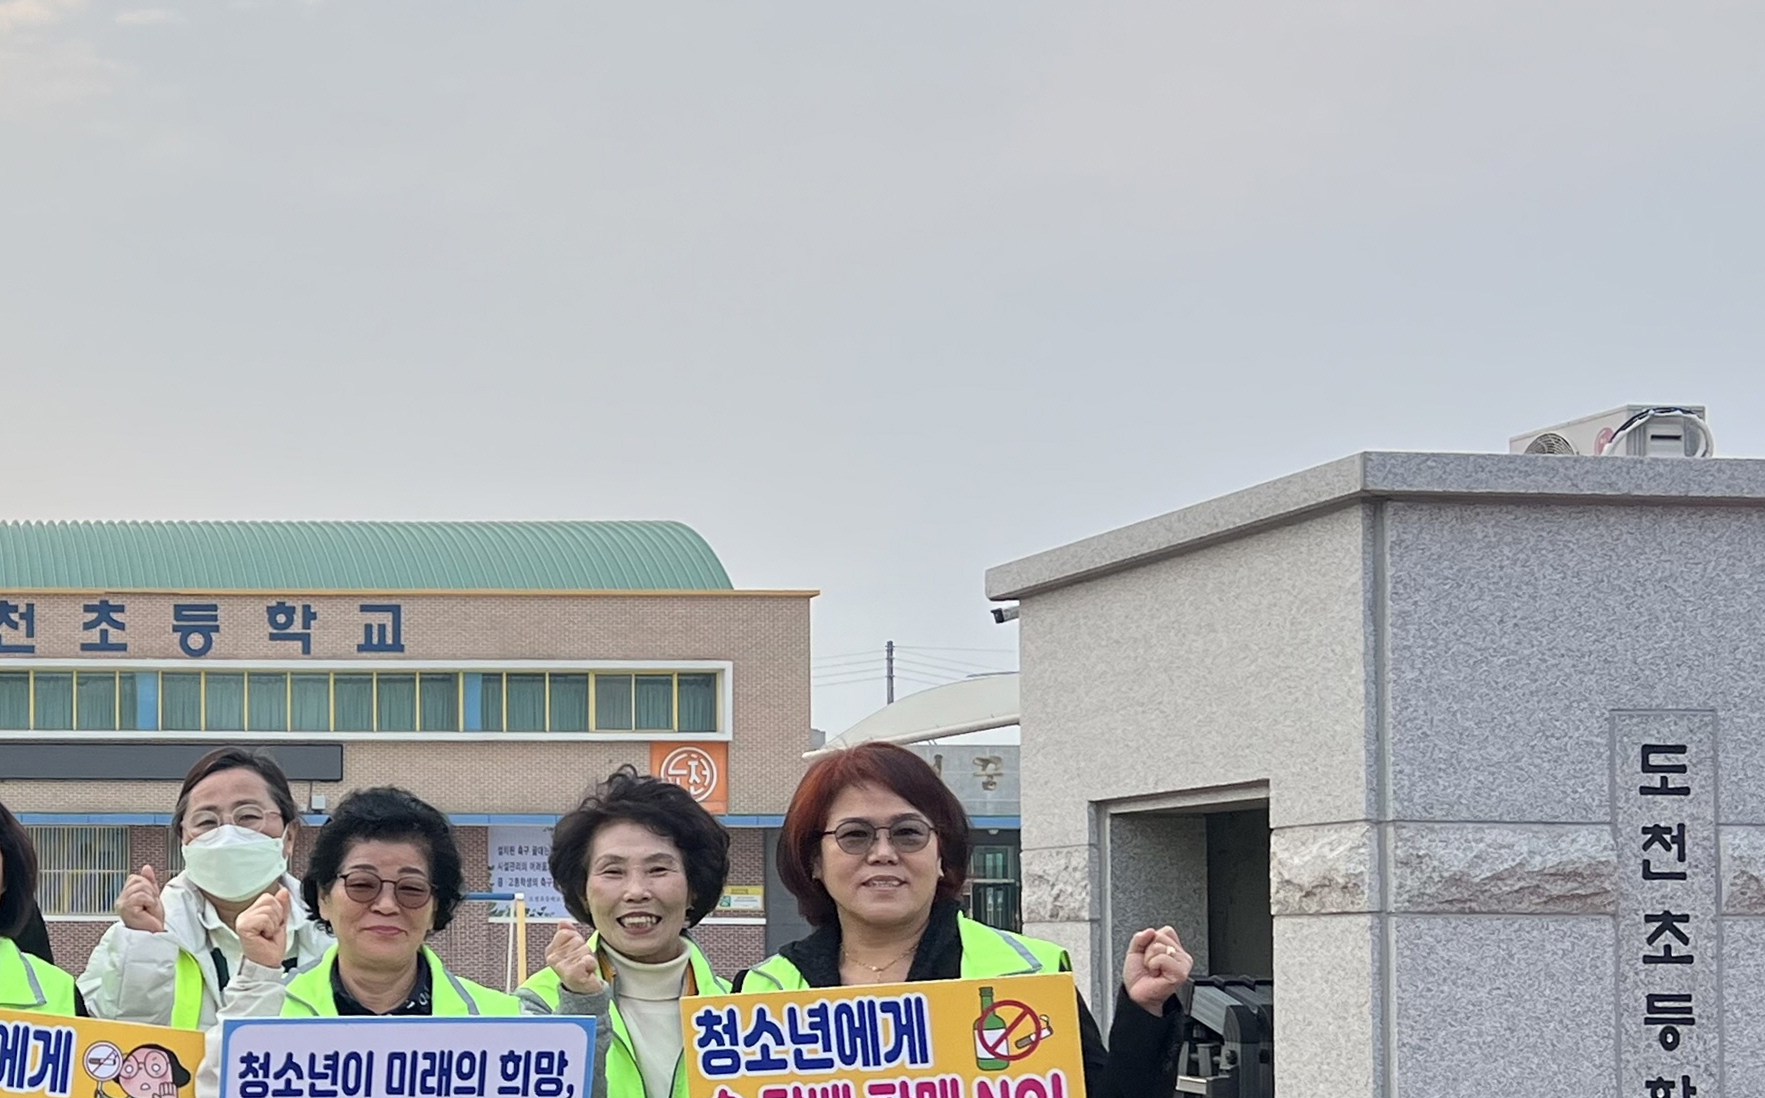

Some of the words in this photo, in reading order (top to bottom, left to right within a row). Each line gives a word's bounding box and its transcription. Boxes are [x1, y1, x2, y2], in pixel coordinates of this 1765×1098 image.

[695, 996, 929, 1076] 청소년에게
[238, 1050, 374, 1098] 청소년이
[386, 1050, 487, 1097] 미래의
